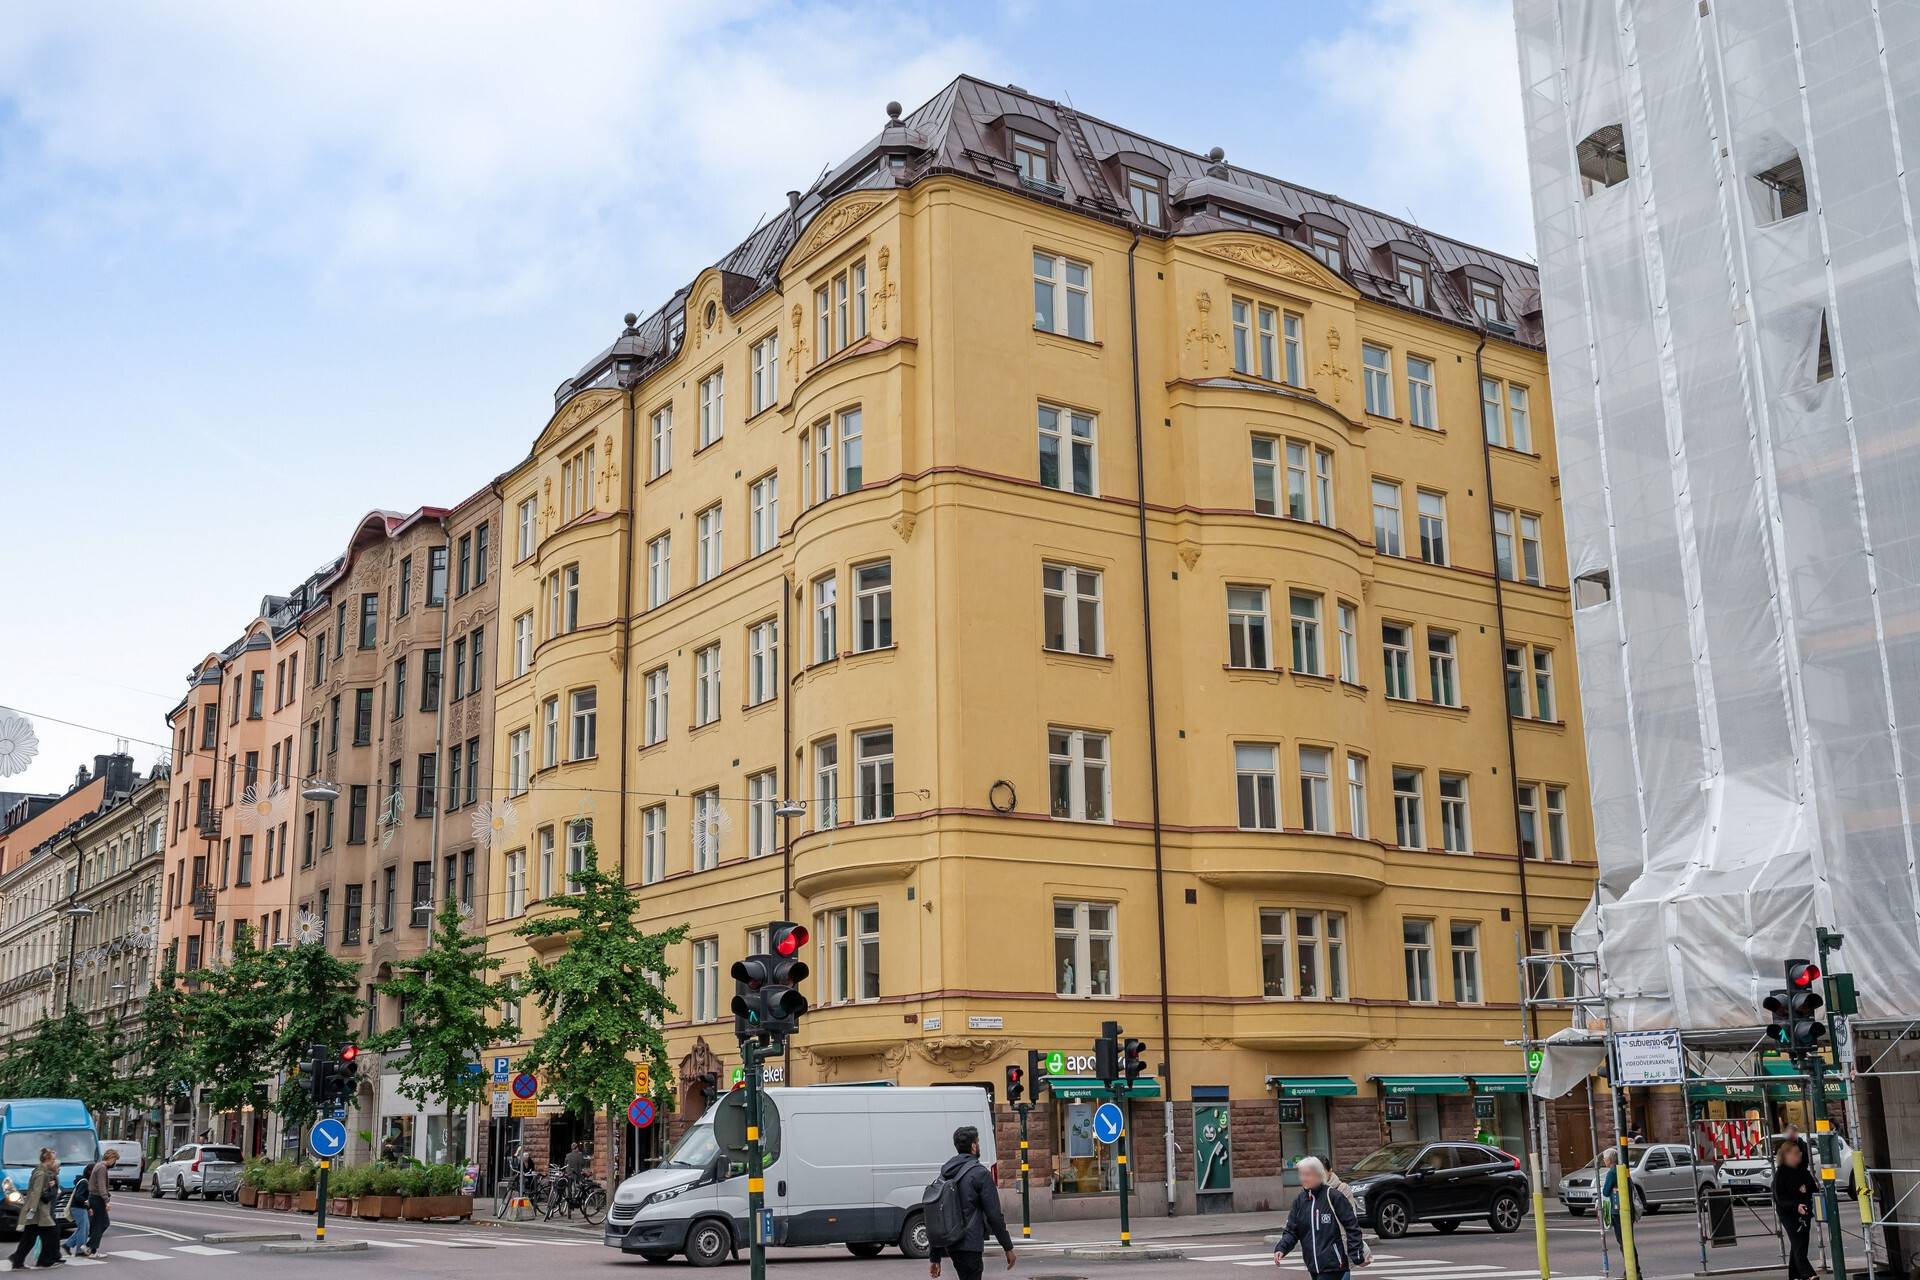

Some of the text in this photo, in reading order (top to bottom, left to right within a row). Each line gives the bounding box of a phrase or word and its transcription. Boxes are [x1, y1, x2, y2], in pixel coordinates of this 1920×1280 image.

[497, 1058, 507, 1073] P
[763, 1065, 784, 1082] eket
[1069, 1089, 1092, 1097] apoteket
